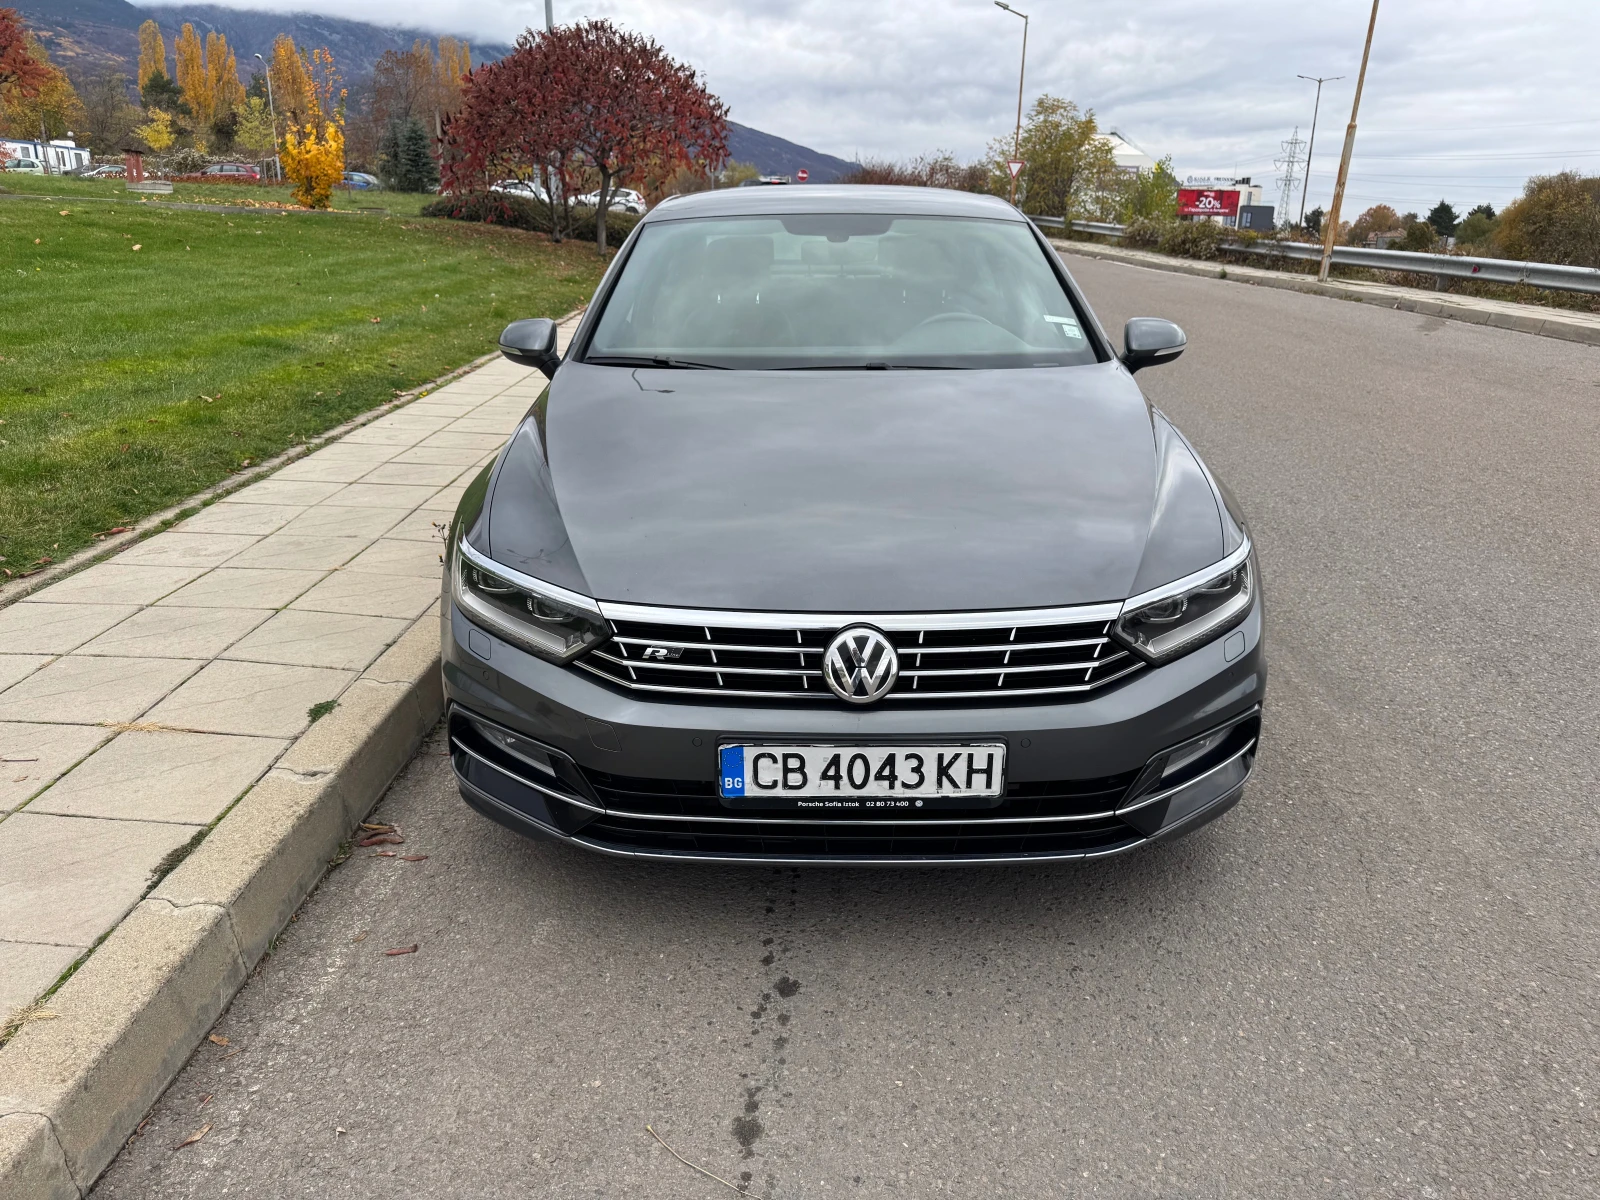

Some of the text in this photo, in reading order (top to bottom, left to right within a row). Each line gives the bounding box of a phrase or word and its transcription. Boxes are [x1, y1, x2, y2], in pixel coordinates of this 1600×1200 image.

[1195, 197, 1221, 208] -20%
[642, 647, 668, 660] R
[752, 752, 995, 791] CB 4043 KH
[724, 778, 743, 789] BG
